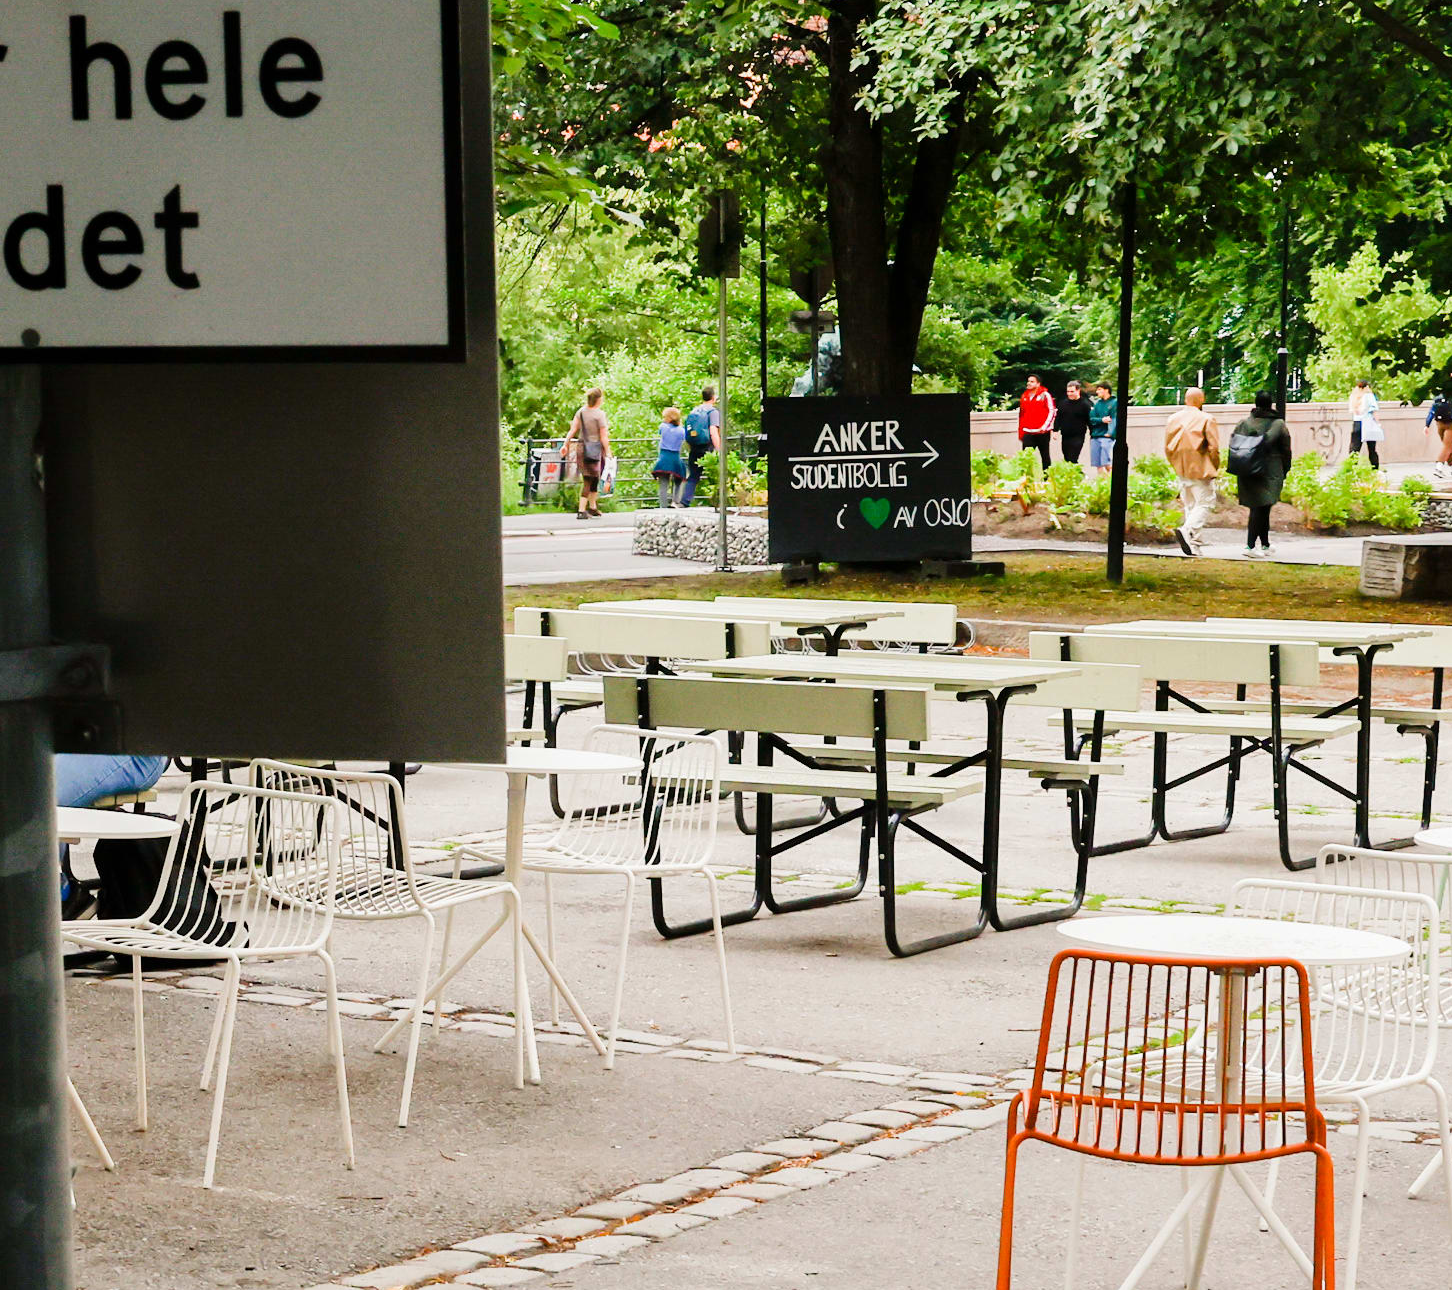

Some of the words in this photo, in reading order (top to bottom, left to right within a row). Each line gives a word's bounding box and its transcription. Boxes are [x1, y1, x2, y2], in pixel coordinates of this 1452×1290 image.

[70, 11, 324, 121] hele
[813, 420, 905, 453] ANKER
[893, 506, 918, 528] AV
[924, 498, 971, 527] OSLO
